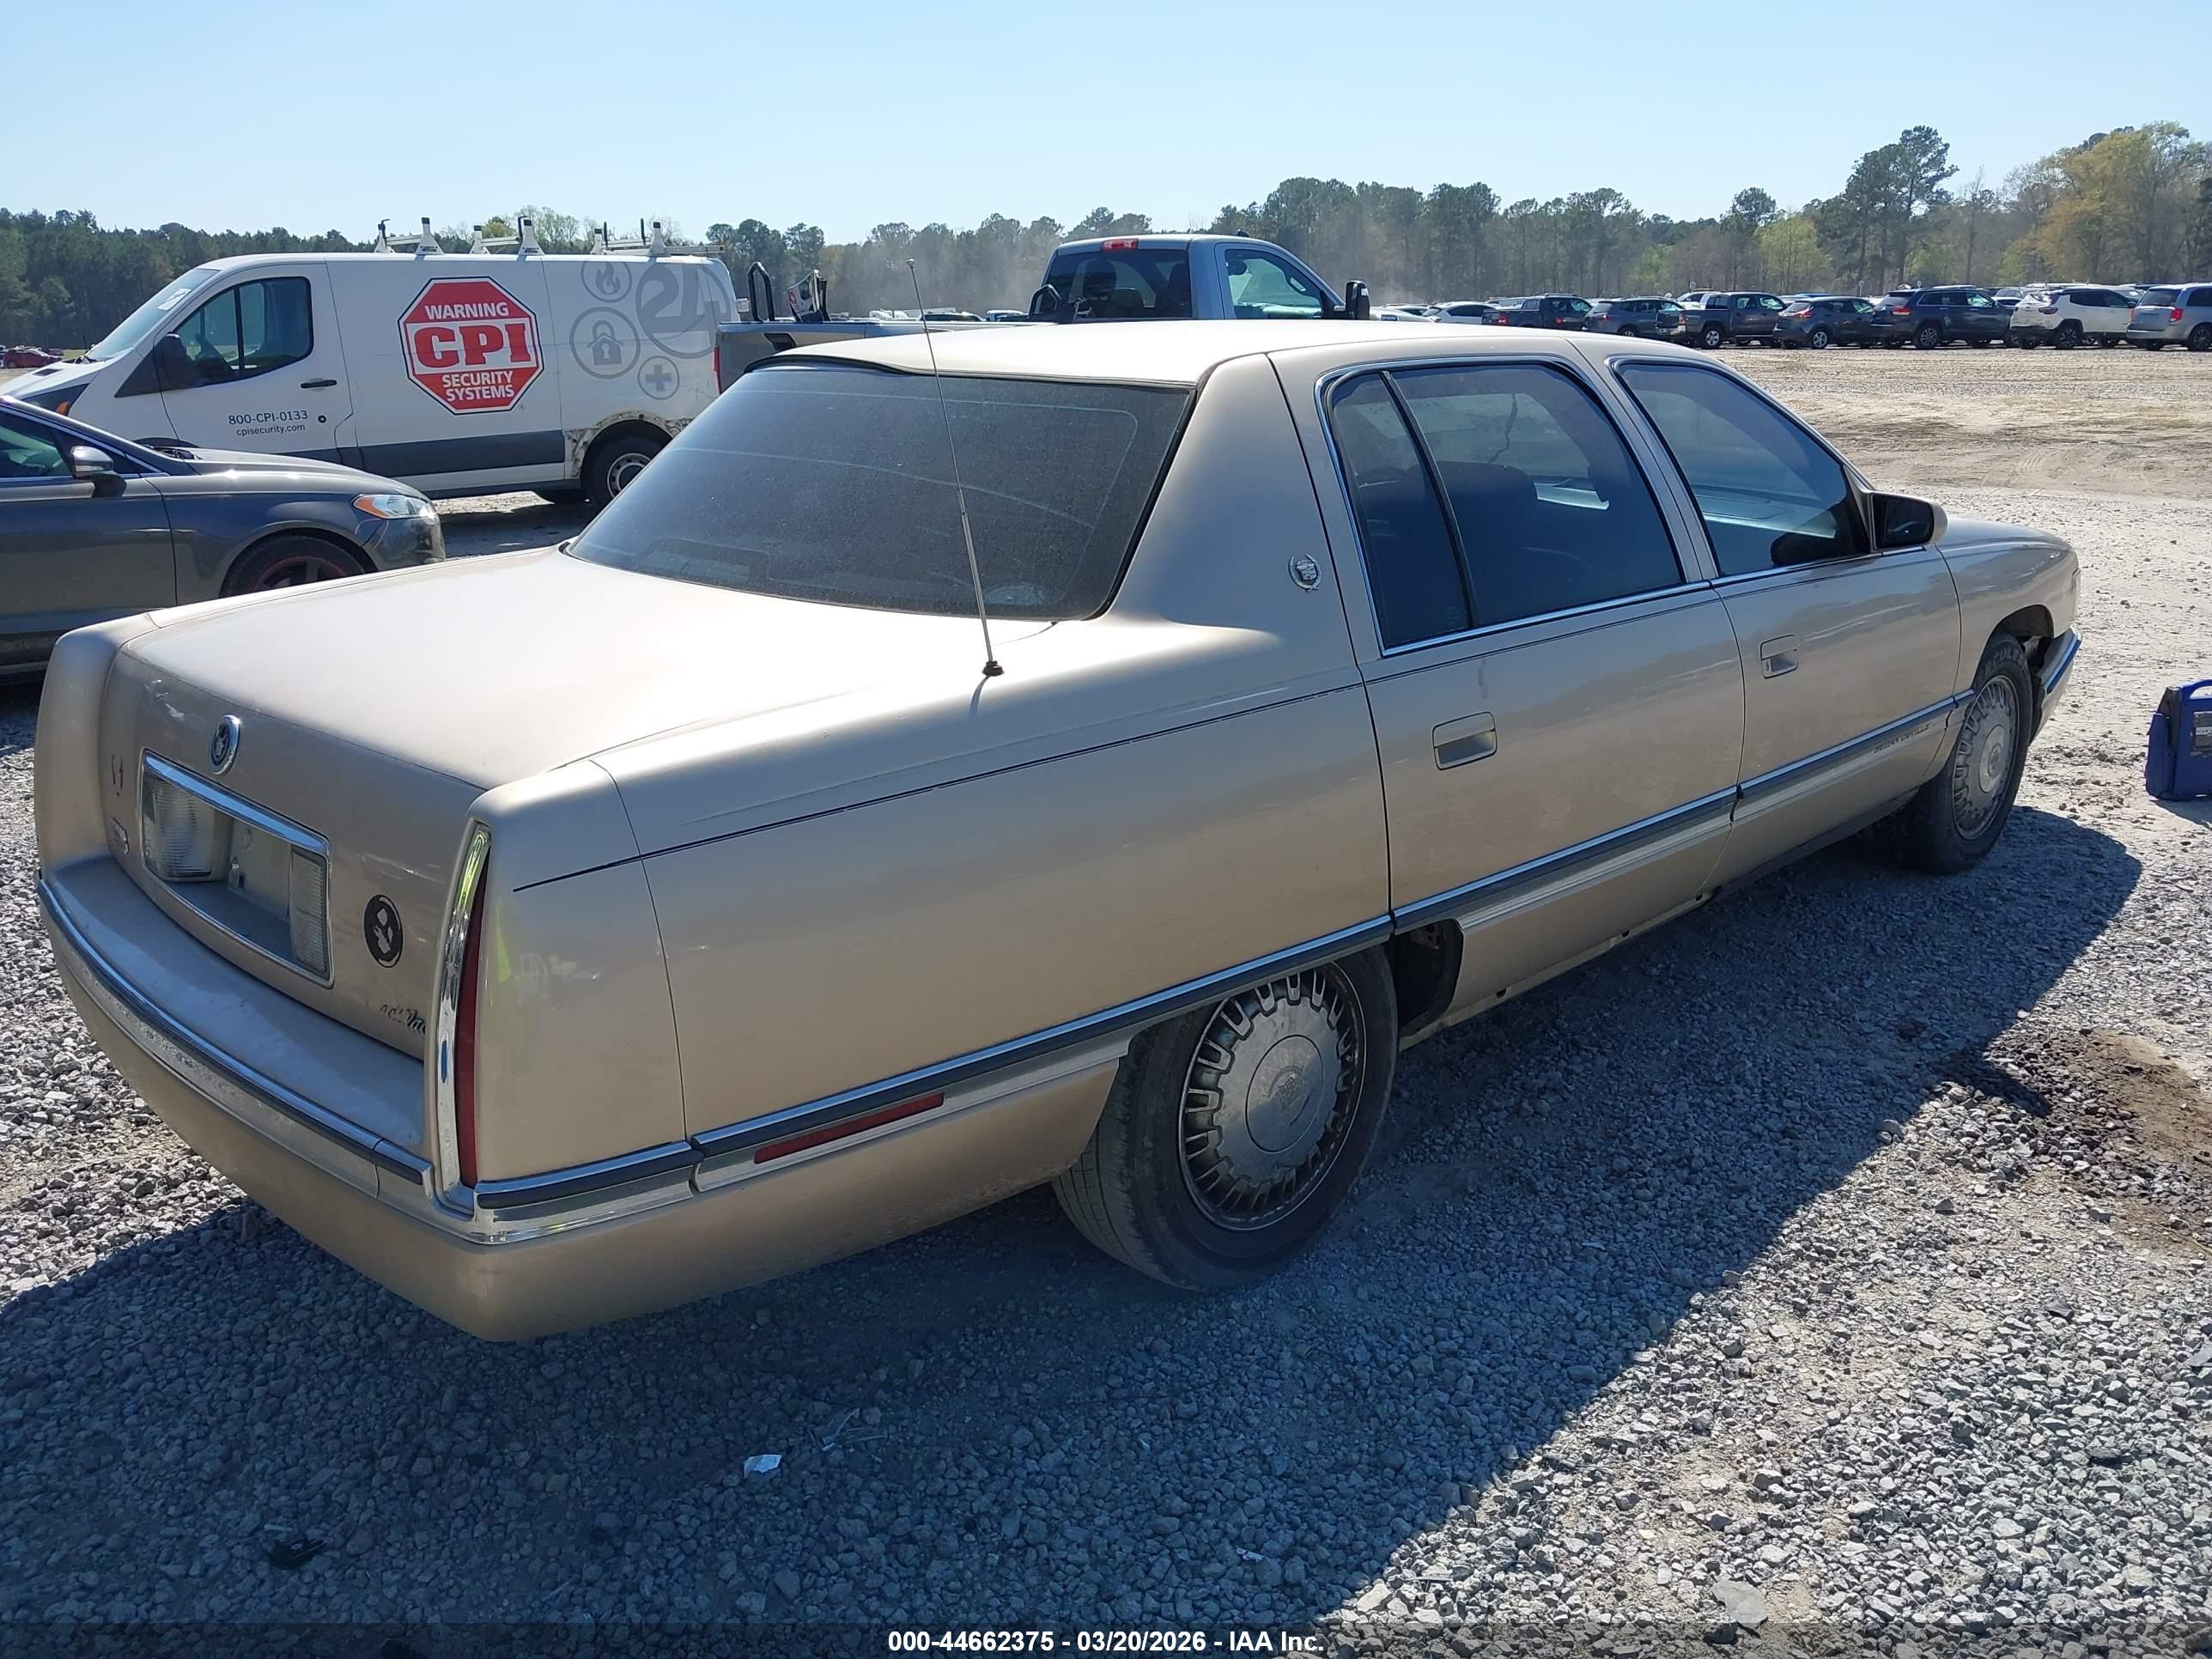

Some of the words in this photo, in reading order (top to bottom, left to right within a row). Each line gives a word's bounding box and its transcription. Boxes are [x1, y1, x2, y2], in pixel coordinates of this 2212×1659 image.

[425, 302, 509, 320] WARNING
[414, 323, 532, 368] CPI
[442, 371, 514, 388] SECURITY
[446, 385, 515, 402] SYSTEMS
[228, 410, 308, 425] 800-CPI-0133
[236, 424, 306, 437] cpisecurity.com
